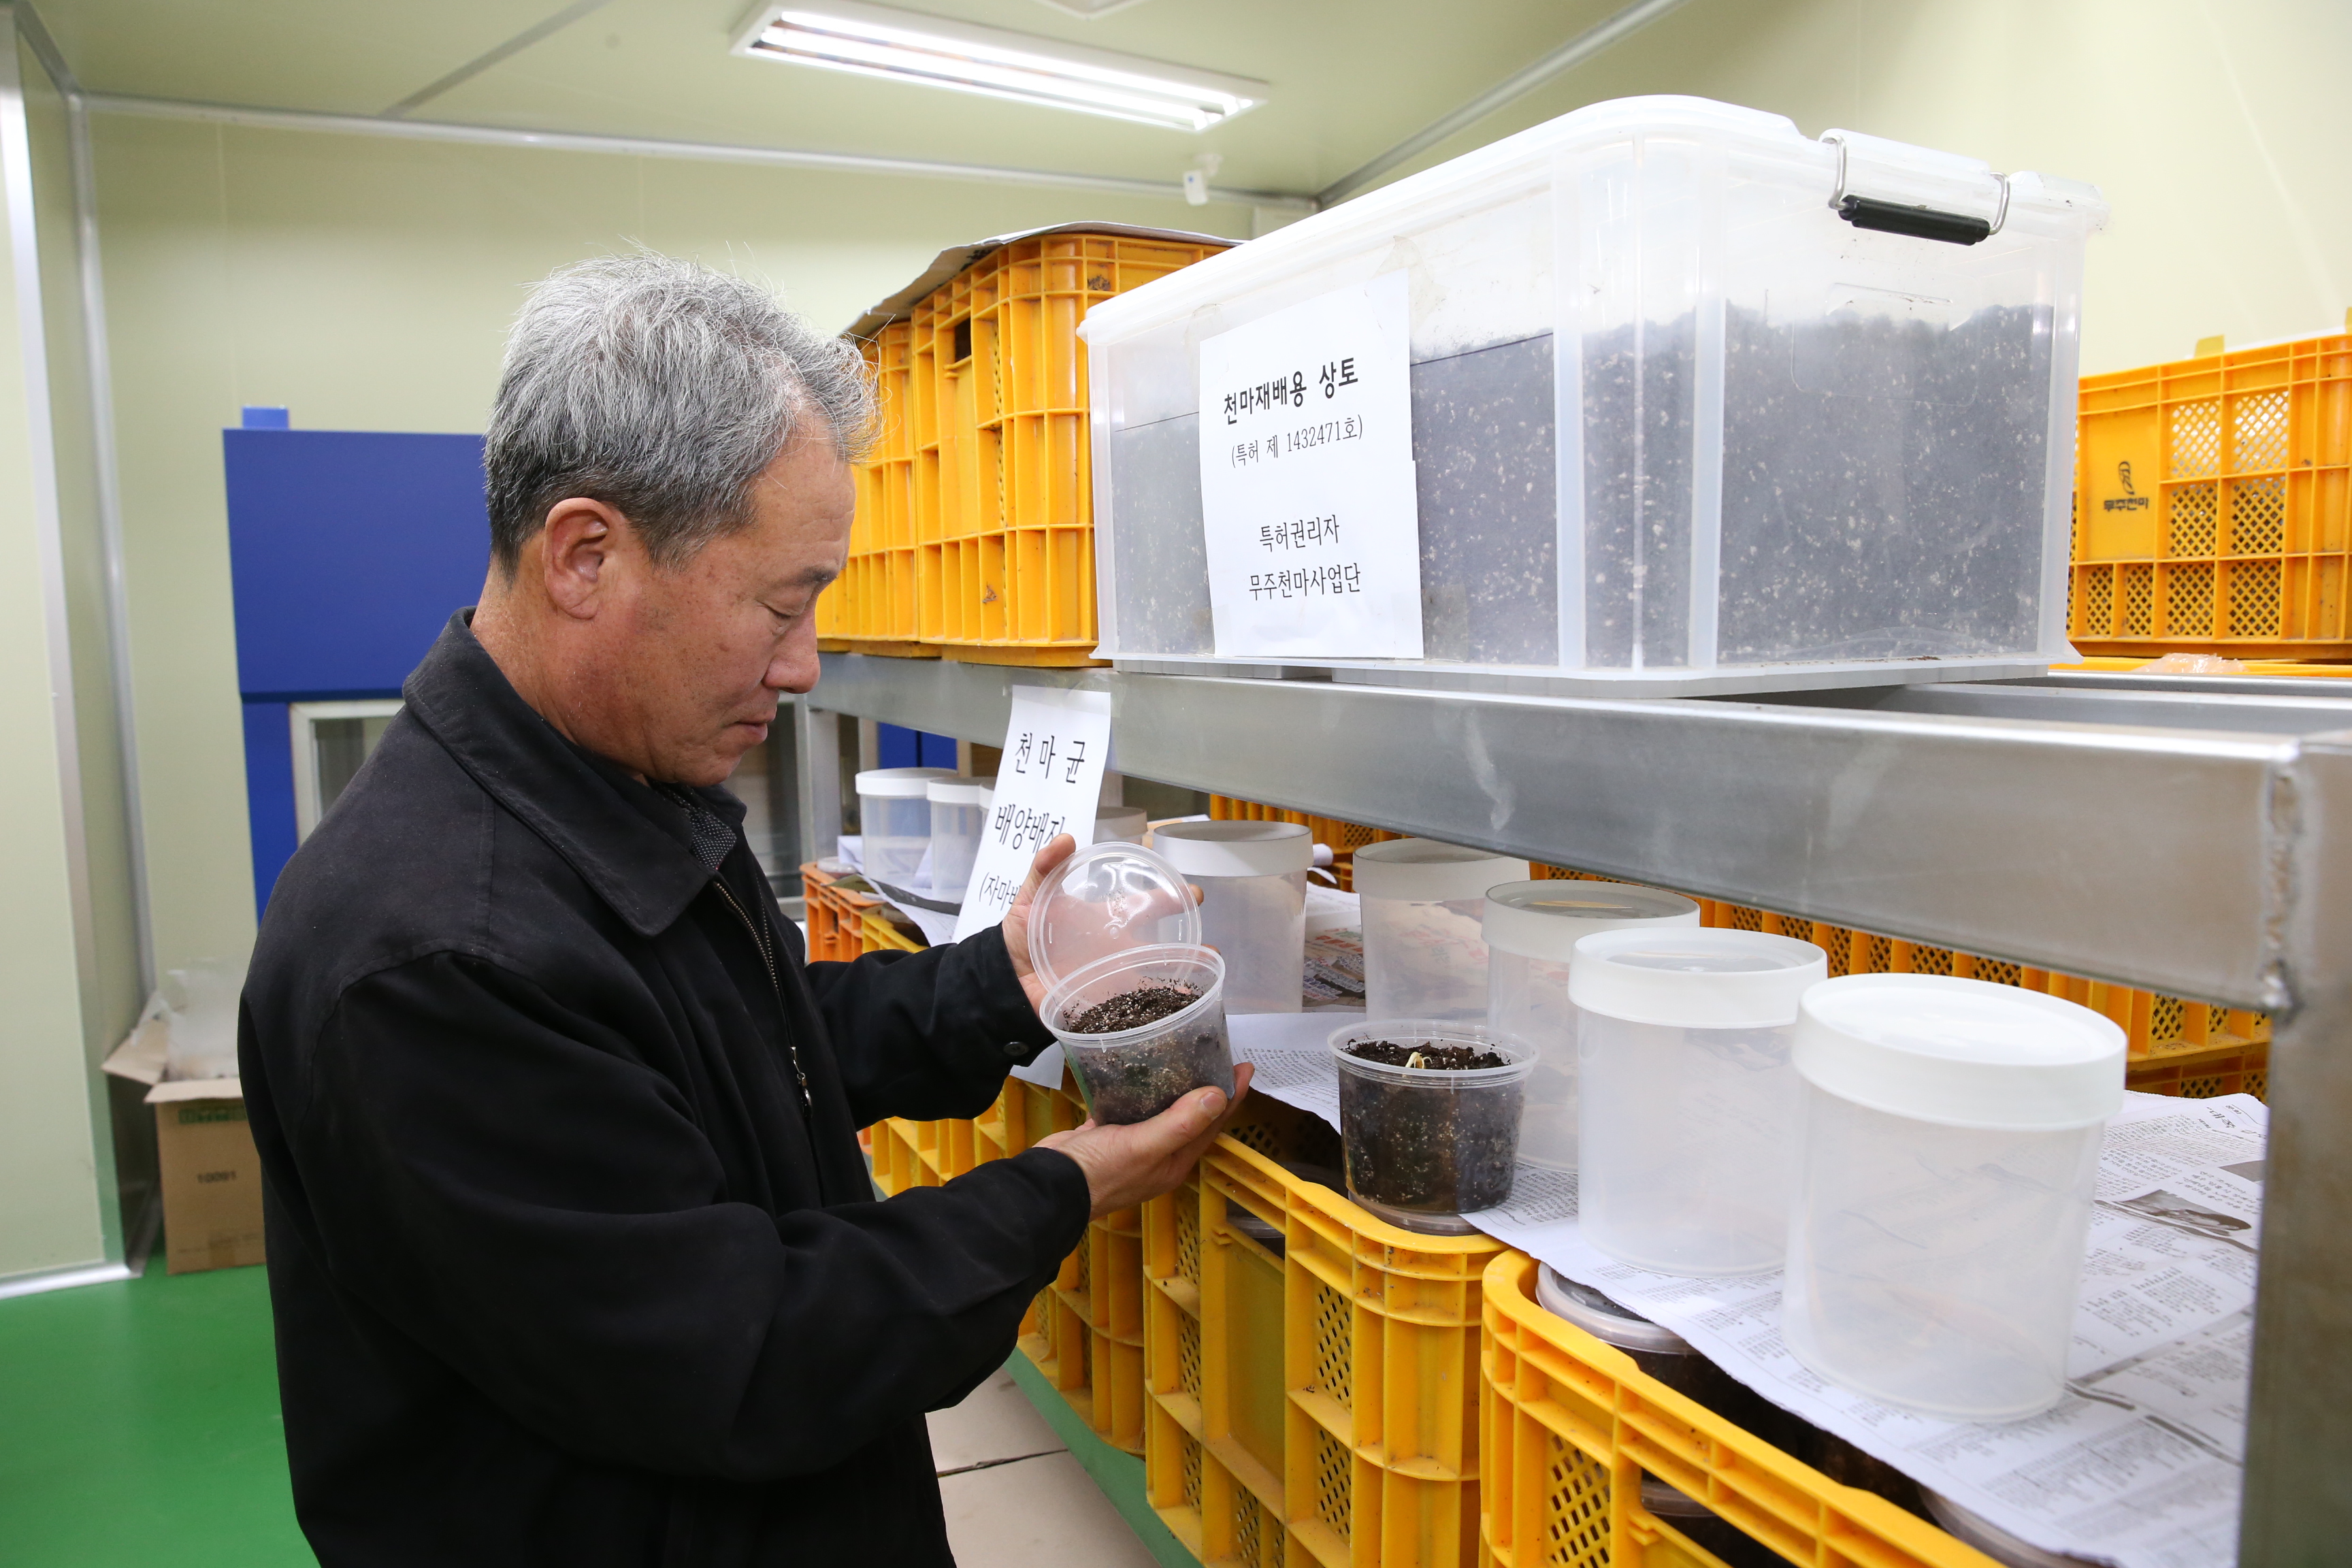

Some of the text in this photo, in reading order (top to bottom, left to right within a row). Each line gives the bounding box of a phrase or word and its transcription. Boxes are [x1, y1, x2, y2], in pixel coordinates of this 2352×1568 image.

[1224, 357, 1359, 425] 천마재배용 상토
[1231, 414, 1363, 468] (특허 제 1432471호)
[1259, 514, 1340, 553] 특허권리자
[1249, 562, 1361, 601] 무주천마사업단
